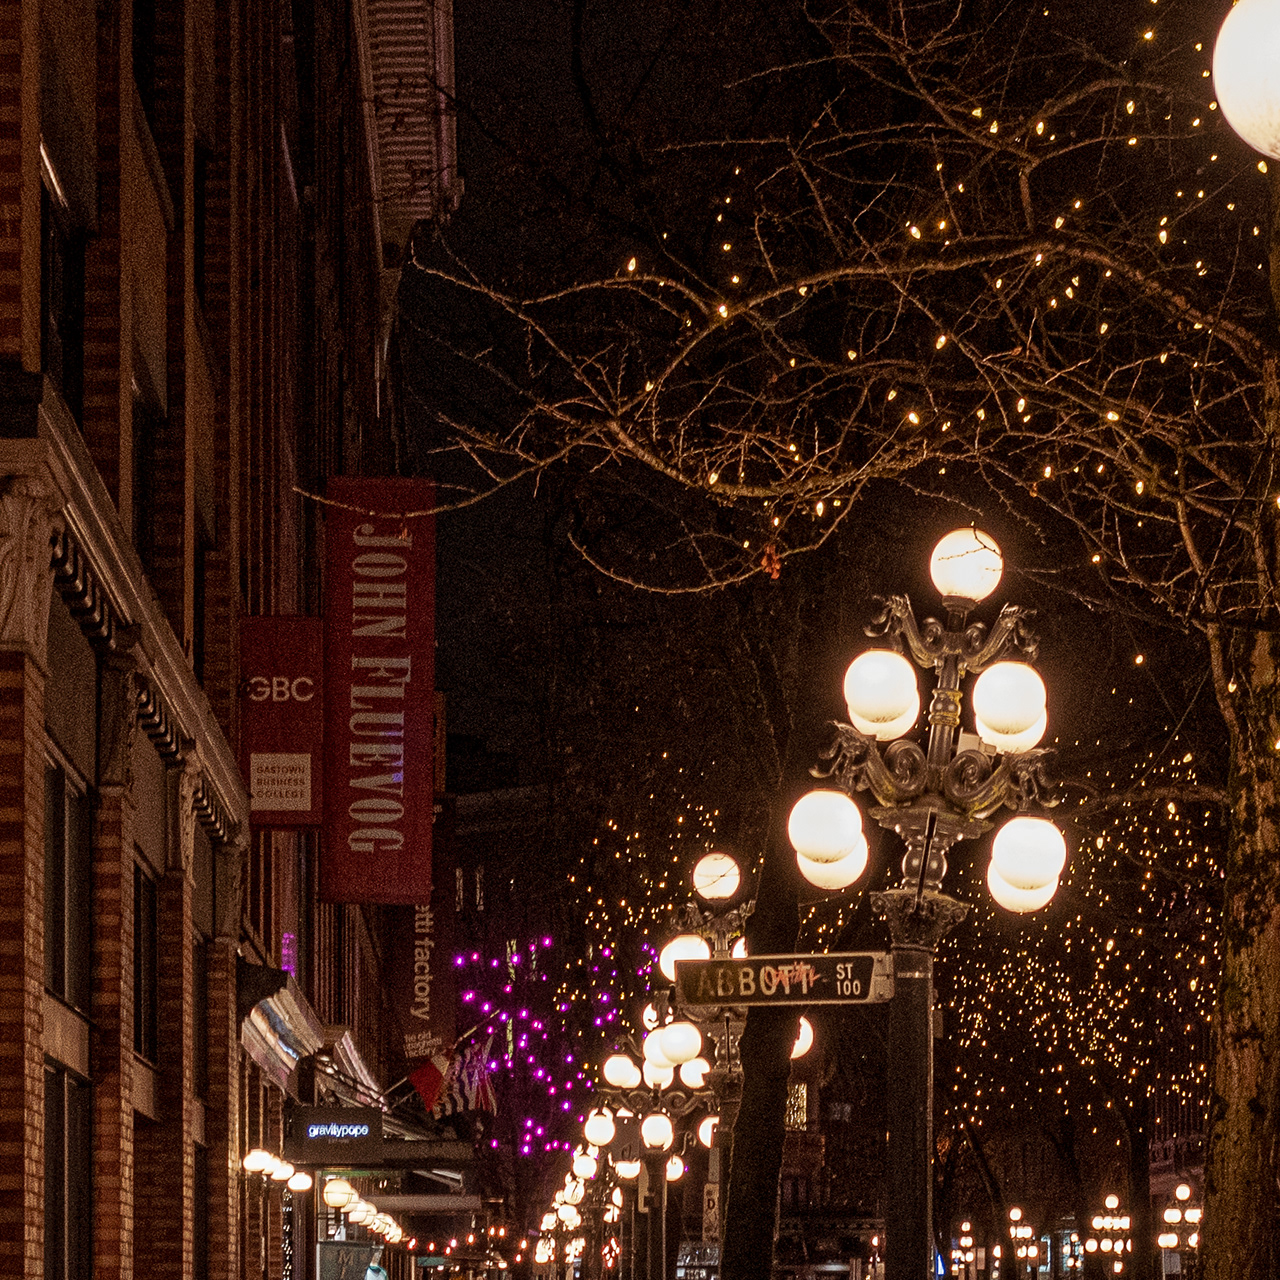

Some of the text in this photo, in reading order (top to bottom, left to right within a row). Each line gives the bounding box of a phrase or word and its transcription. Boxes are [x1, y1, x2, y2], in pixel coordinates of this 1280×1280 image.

[347, 522, 413, 853] JOHN FLUEVOG
[256, 764, 305, 774] GASTOWN
[256, 778, 305, 787] BUSINESS
[256, 790, 304, 799] COLLEGE
[409, 936, 436, 1020] factory
[696, 962, 812, 998] ABBOTT
[836, 962, 854, 980] ST
[836, 980, 862, 997] 100
[308, 1122, 369, 1139] gravitypope
